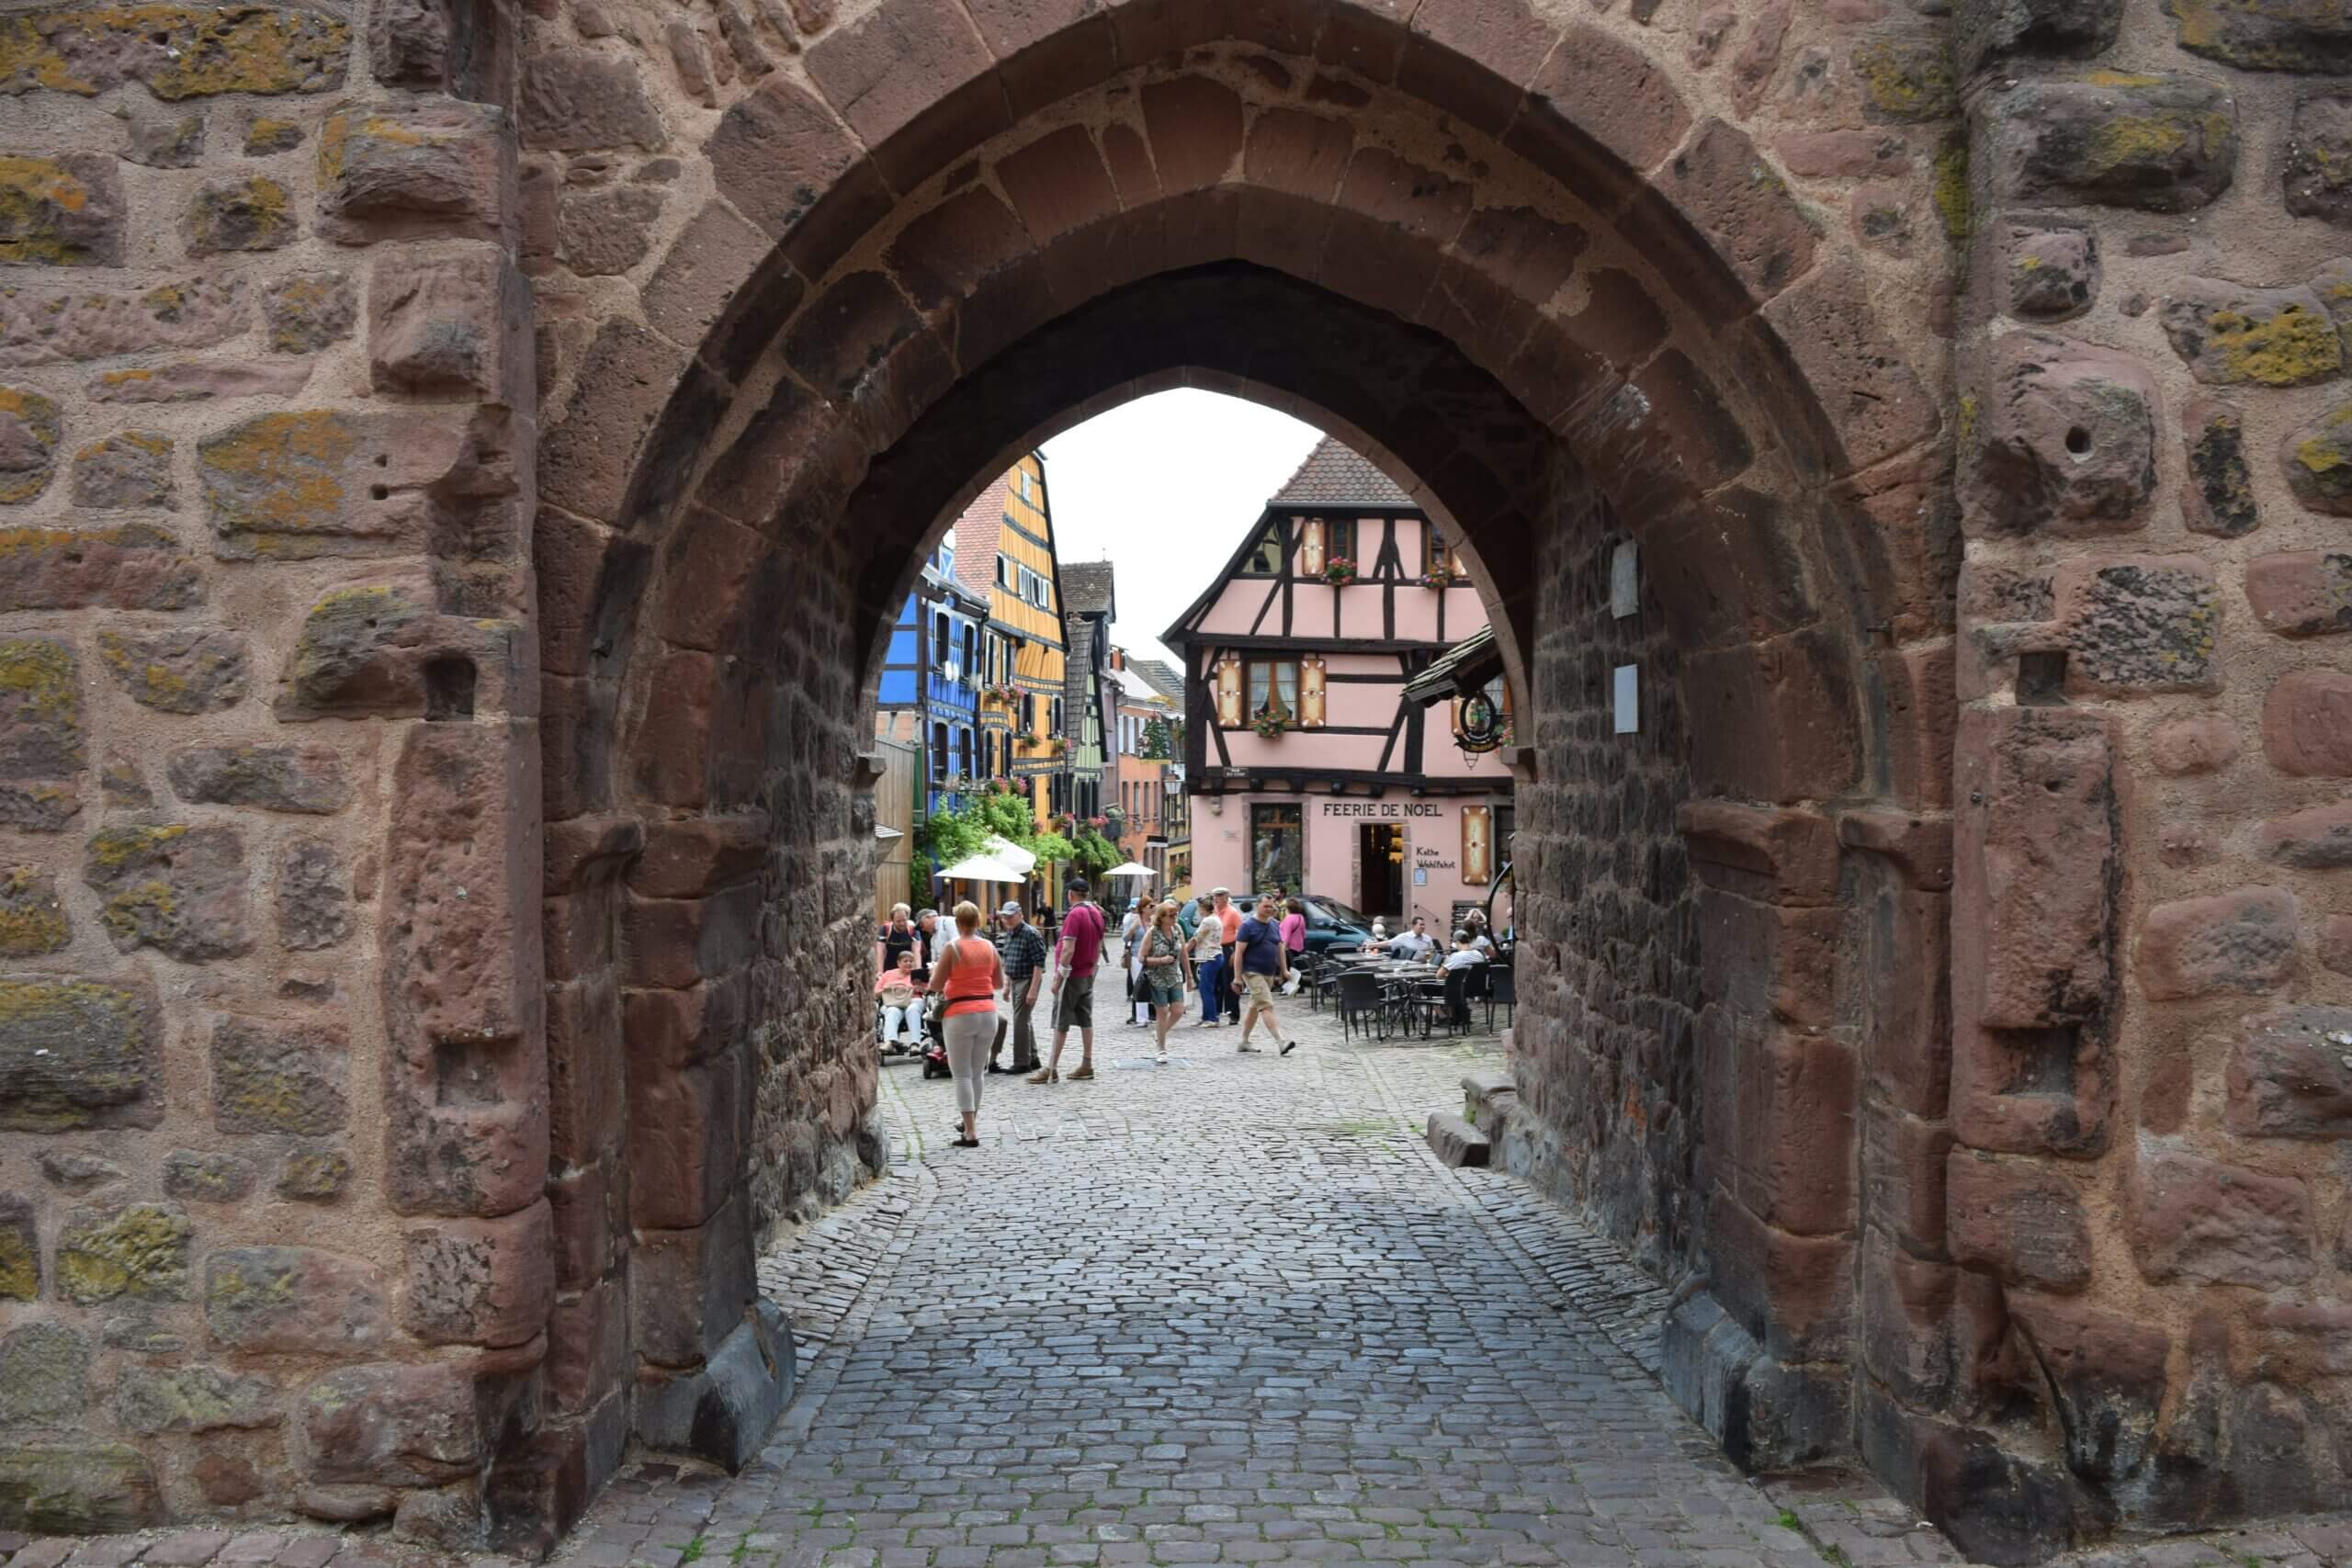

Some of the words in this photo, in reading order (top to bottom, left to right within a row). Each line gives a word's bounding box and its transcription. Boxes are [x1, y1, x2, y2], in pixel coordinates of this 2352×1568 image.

[1323, 803, 1376, 817] FEERIE
[1381, 804, 1399, 817] DE
[1404, 804, 1443, 817] NOEL
